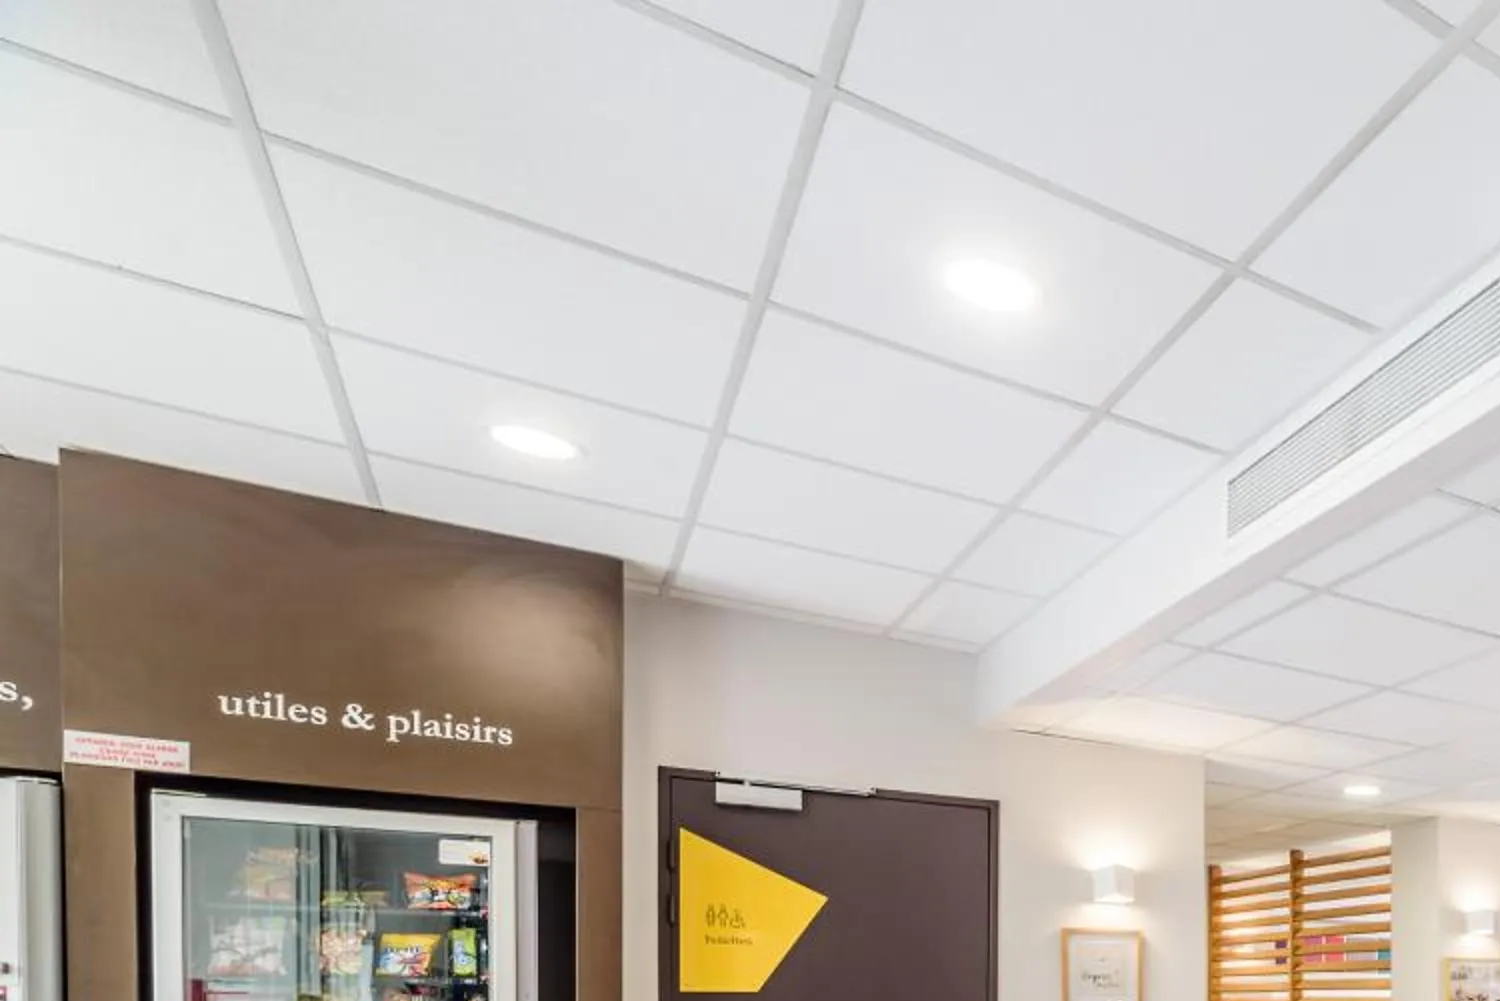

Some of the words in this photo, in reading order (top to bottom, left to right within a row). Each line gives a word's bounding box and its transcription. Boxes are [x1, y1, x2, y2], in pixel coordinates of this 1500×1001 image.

[218, 692, 328, 726] utiles
[341, 703, 376, 731] &
[386, 708, 514, 746] plaisirs
